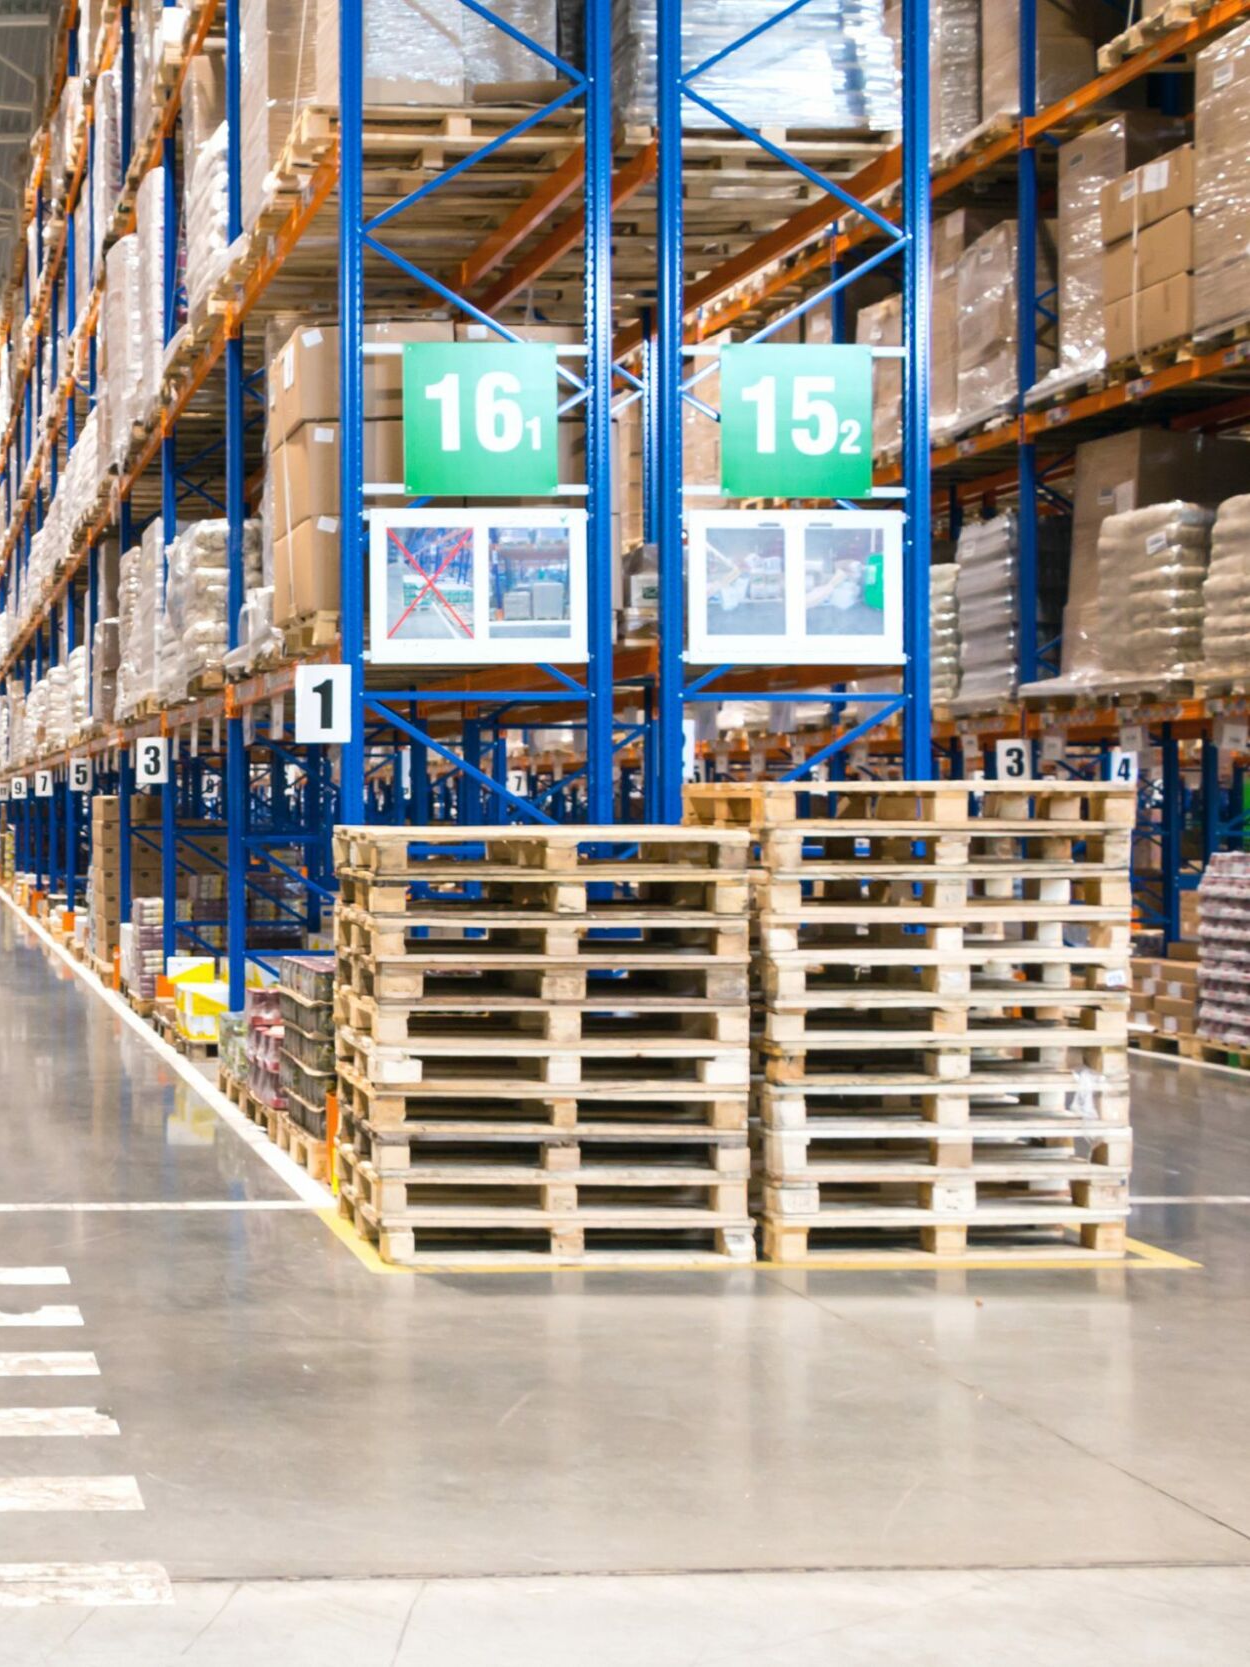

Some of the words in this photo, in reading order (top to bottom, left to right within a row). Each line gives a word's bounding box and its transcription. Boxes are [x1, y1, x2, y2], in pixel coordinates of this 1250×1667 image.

[311, 678, 334, 730] 1
[143, 745, 161, 776] 3
[1005, 747, 1025, 777] 3
[1116, 757, 1131, 781] 4
[40, 775, 48, 792] 7
[75, 764, 88, 786] 5
